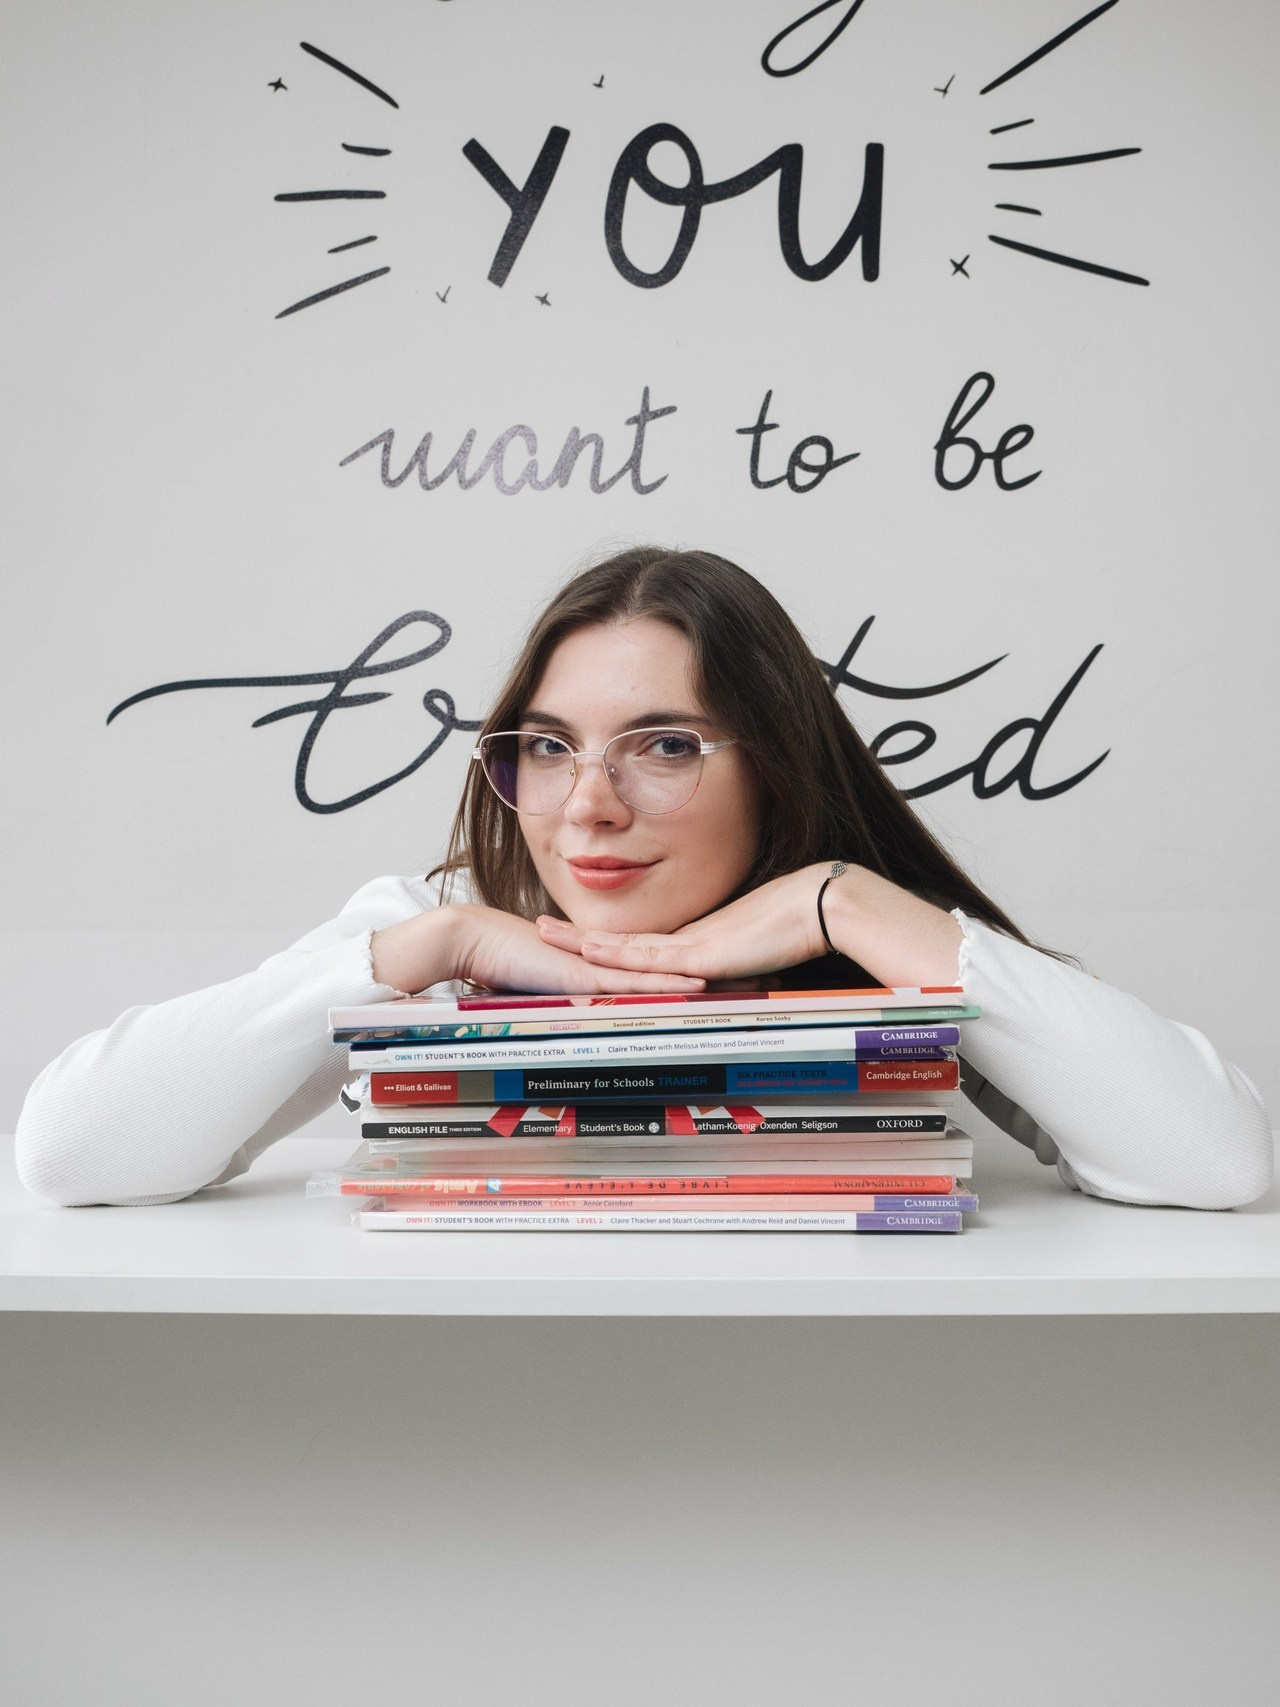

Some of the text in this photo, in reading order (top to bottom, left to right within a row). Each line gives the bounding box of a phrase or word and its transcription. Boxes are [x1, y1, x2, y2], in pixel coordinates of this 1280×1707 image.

[339, 371, 1043, 495] want to be
[881, 1031, 938, 1041] CAMBRIDGE
[630, 1044, 656, 1052] Thacker
[674, 1042, 699, 1050] Melissa
[700, 1041, 722, 1049] Wilson
[723, 1040, 736, 1048] and
[425, 1052, 465, 1060] STUDENT'S
[737, 1069, 827, 1079] SIX PRACTICE TESTS
[866, 1070, 942, 1081] Cambridge English
[423, 1083, 452, 1091] Gallivan
[528, 1076, 708, 1091] Preliminary for Schools TRAINER
[523, 1123, 645, 1134] Elementary Student's Book
[692, 1120, 838, 1132] Latham-Koenig Oxenden Seligson
[877, 1119, 923, 1129] OXFORD
[388, 1126, 428, 1134] ENGLISH
[680, 1181, 729, 1189] LIVRE
[904, 1199, 960, 1208] CAMBRIDGE
[798, 1217, 819, 1225] Daniel
[820, 1217, 845, 1225] Vincent
[887, 1216, 943, 1225] CAMBRIDGE
